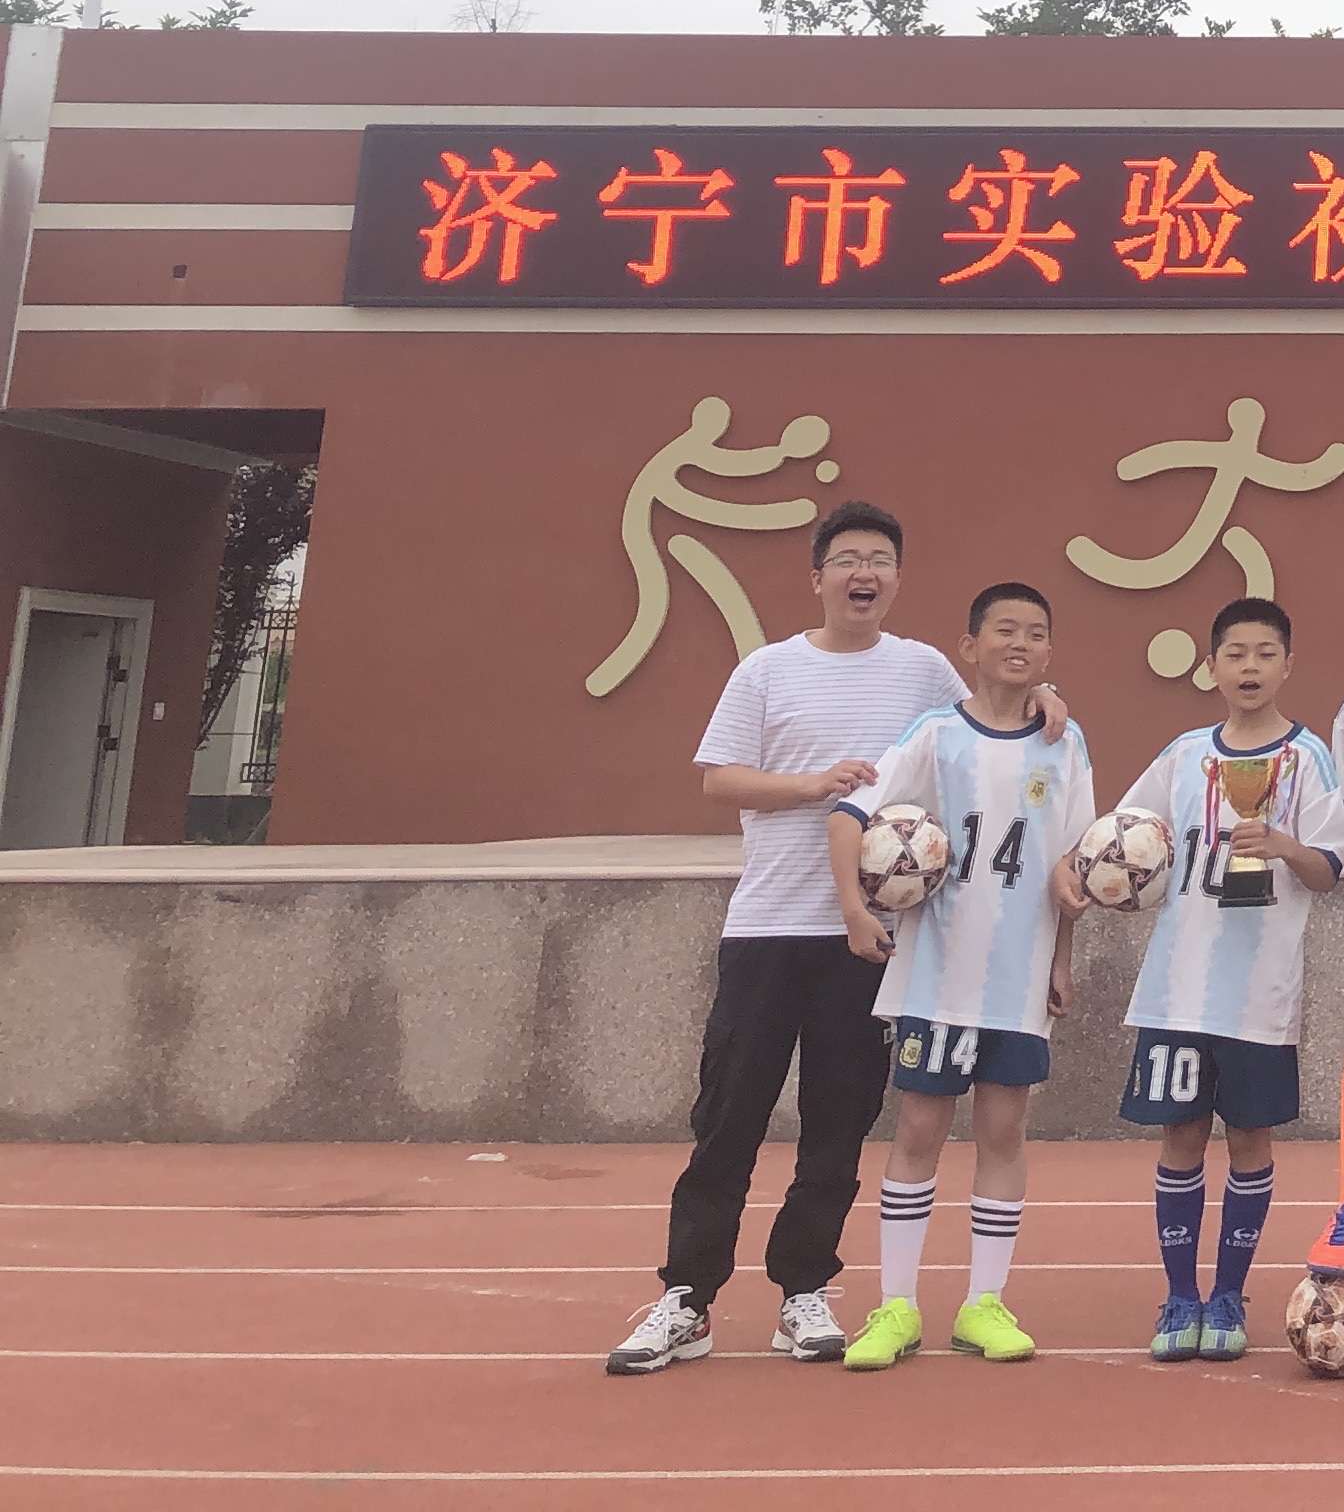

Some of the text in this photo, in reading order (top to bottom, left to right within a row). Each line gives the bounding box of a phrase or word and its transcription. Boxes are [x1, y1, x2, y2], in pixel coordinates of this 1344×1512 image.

[956, 810, 1029, 889] 14
[928, 1020, 980, 1076] 14
[1148, 1043, 1202, 1103] 10
